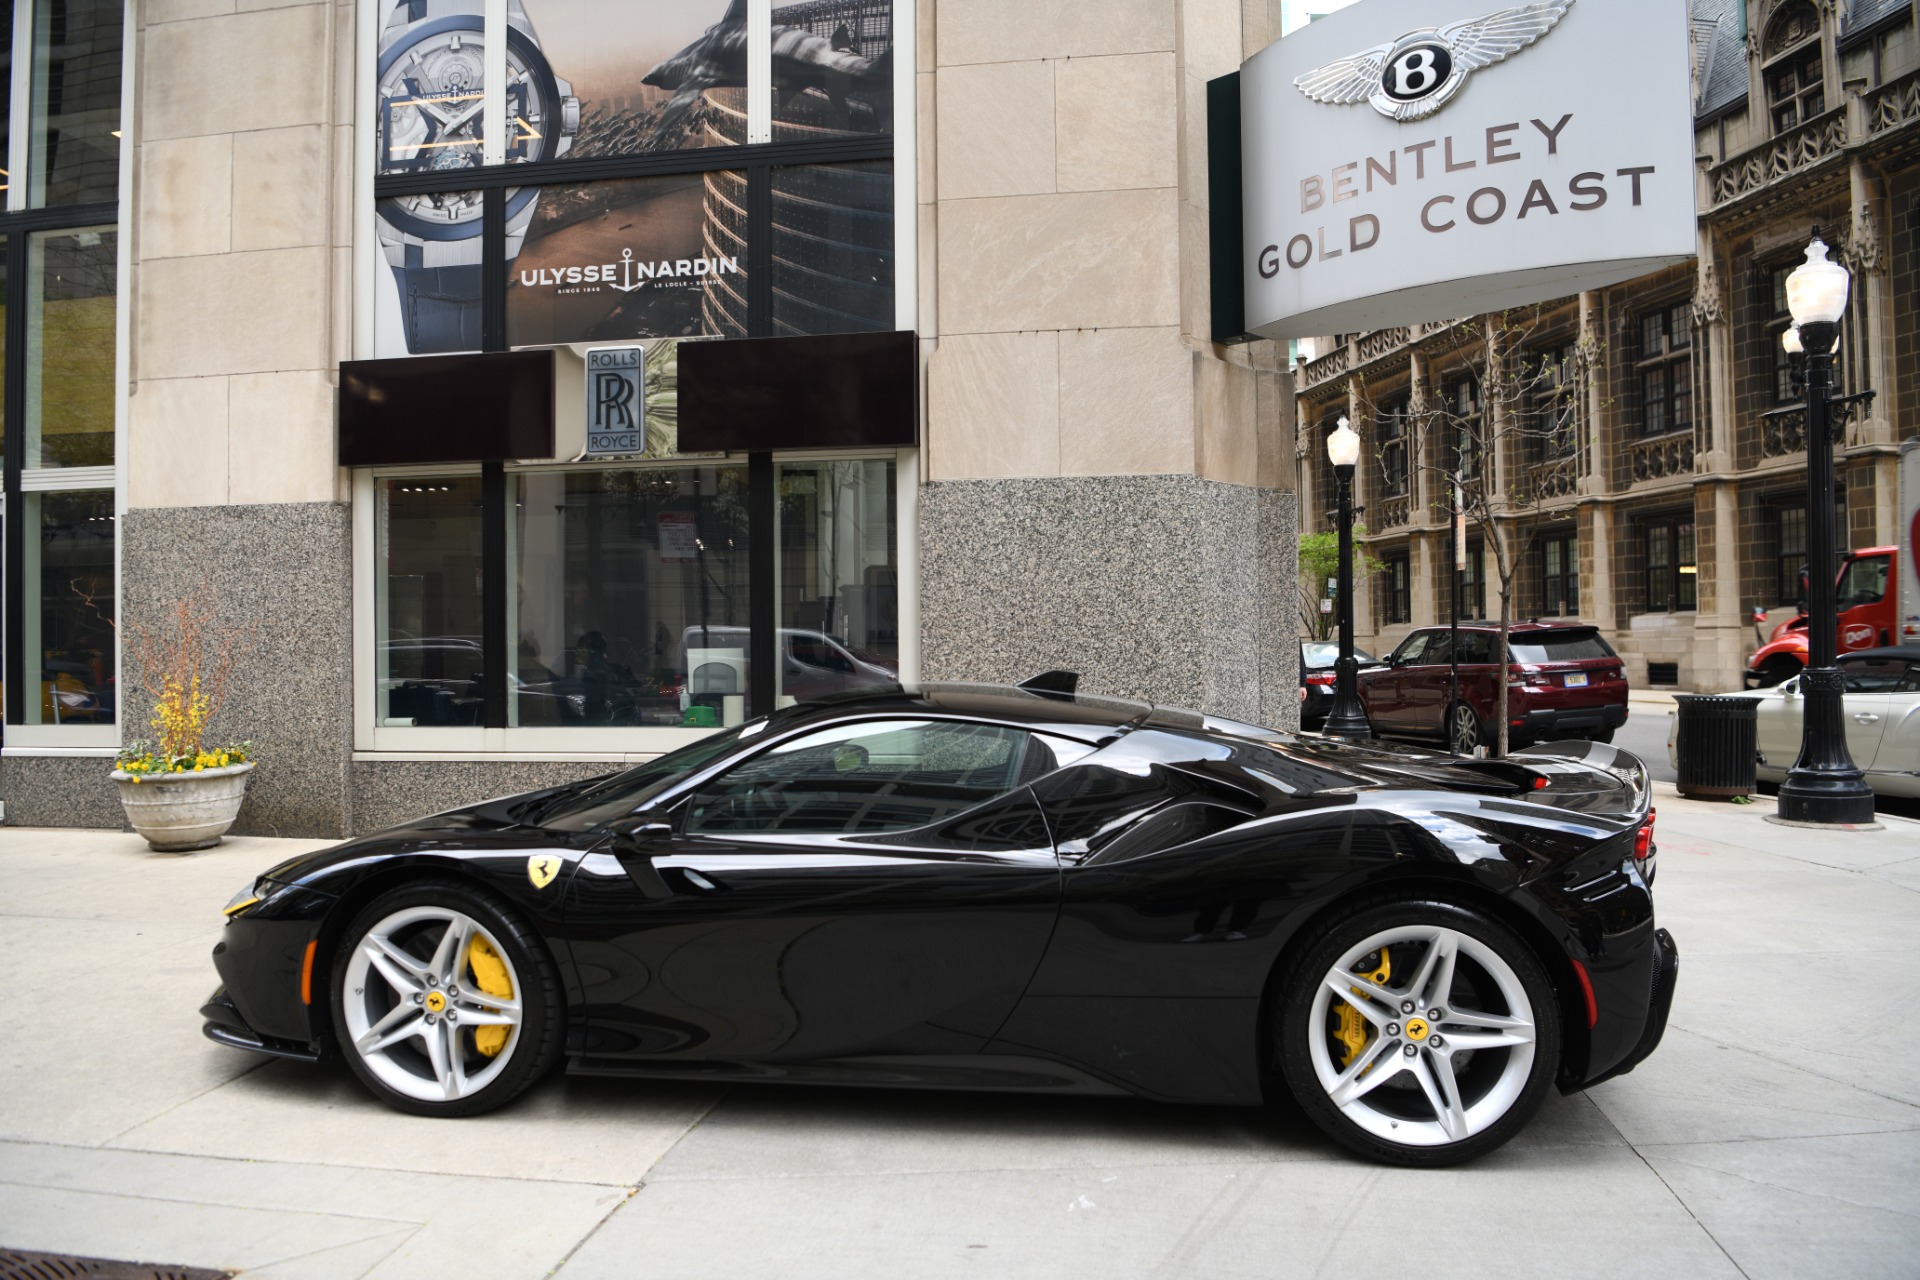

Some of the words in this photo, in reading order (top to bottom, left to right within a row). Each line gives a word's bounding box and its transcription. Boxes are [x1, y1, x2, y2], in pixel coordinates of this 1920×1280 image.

[1394, 48, 1438, 95] B
[1300, 113, 1573, 214] BENTLEY
[1258, 213, 1381, 280] GOLD
[1420, 165, 1656, 234] COAST
[521, 264, 617, 287] ULYSSE
[637, 256, 738, 280] NARDIN
[557, 287, 580, 295] SINCE
[591, 352, 637, 368] ROLLS
[591, 434, 637, 449] ROYCE
